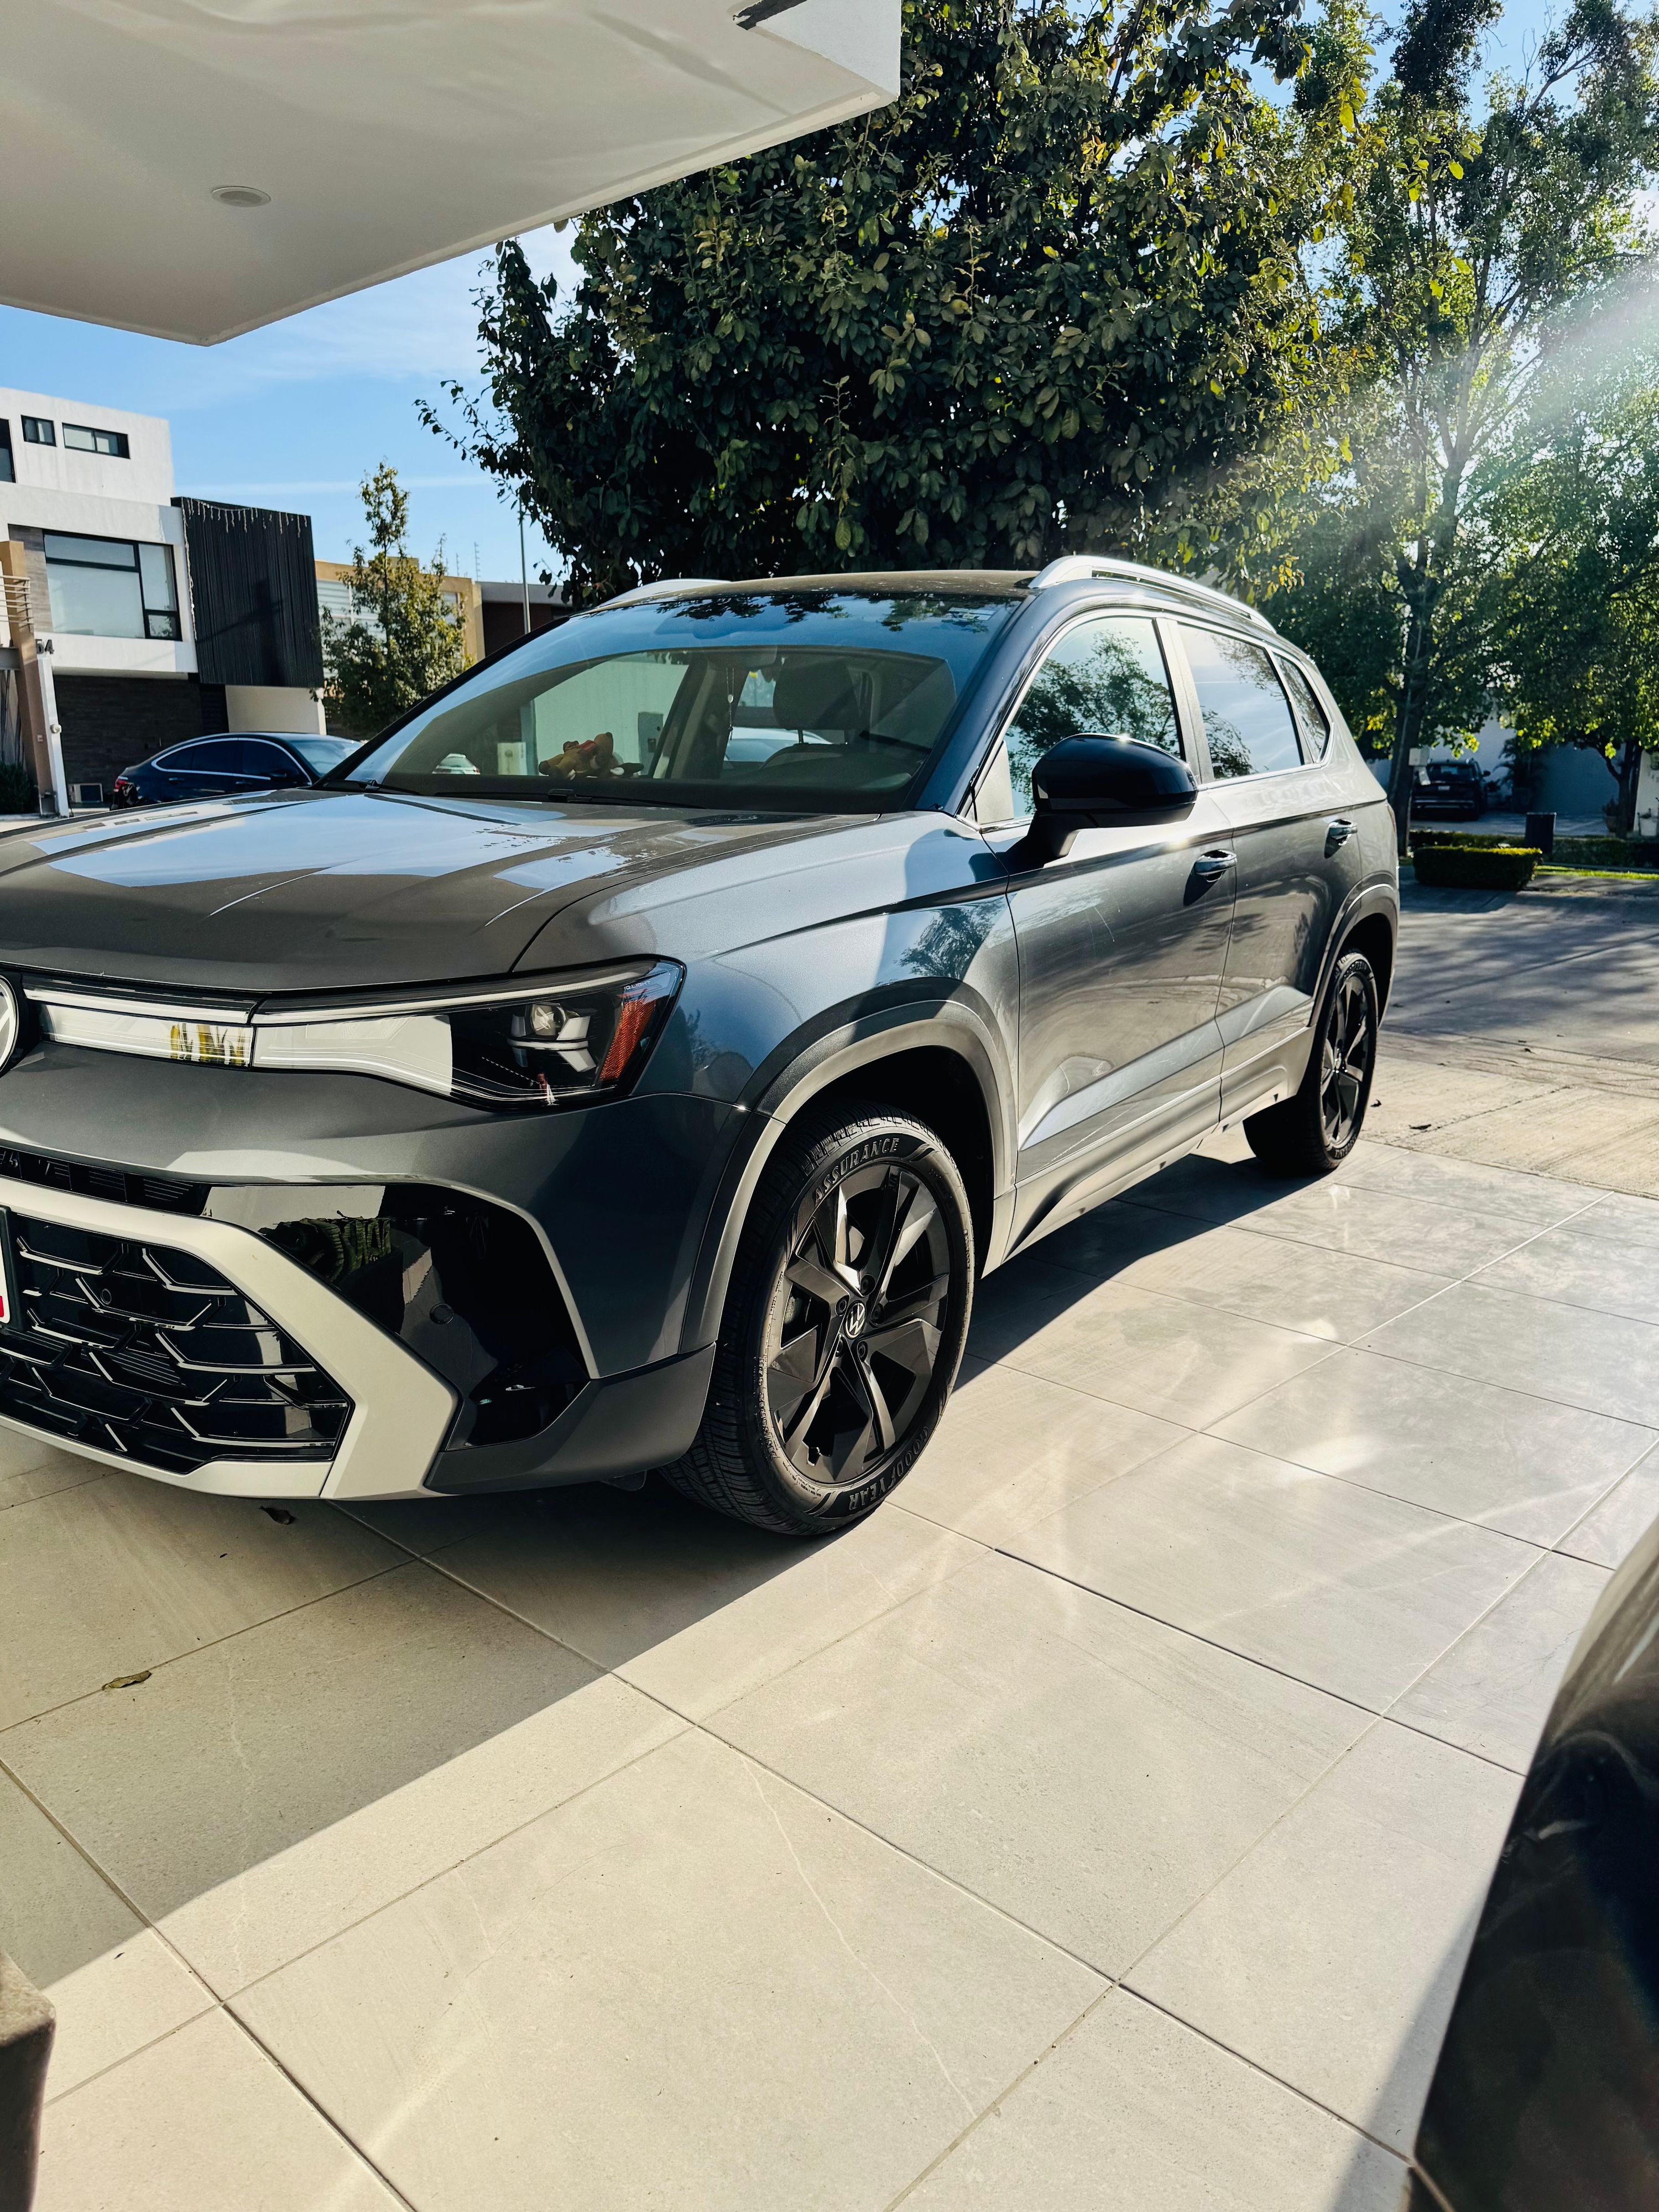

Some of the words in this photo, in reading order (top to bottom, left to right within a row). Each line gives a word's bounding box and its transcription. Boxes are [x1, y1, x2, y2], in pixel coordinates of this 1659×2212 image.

[35, 639, 54, 655] 54
[624, 980, 651, 991] IQ.LIGHT
[815, 1138, 900, 1207] ASSURANCE
[849, 1426, 929, 1511] GOODYEAR
